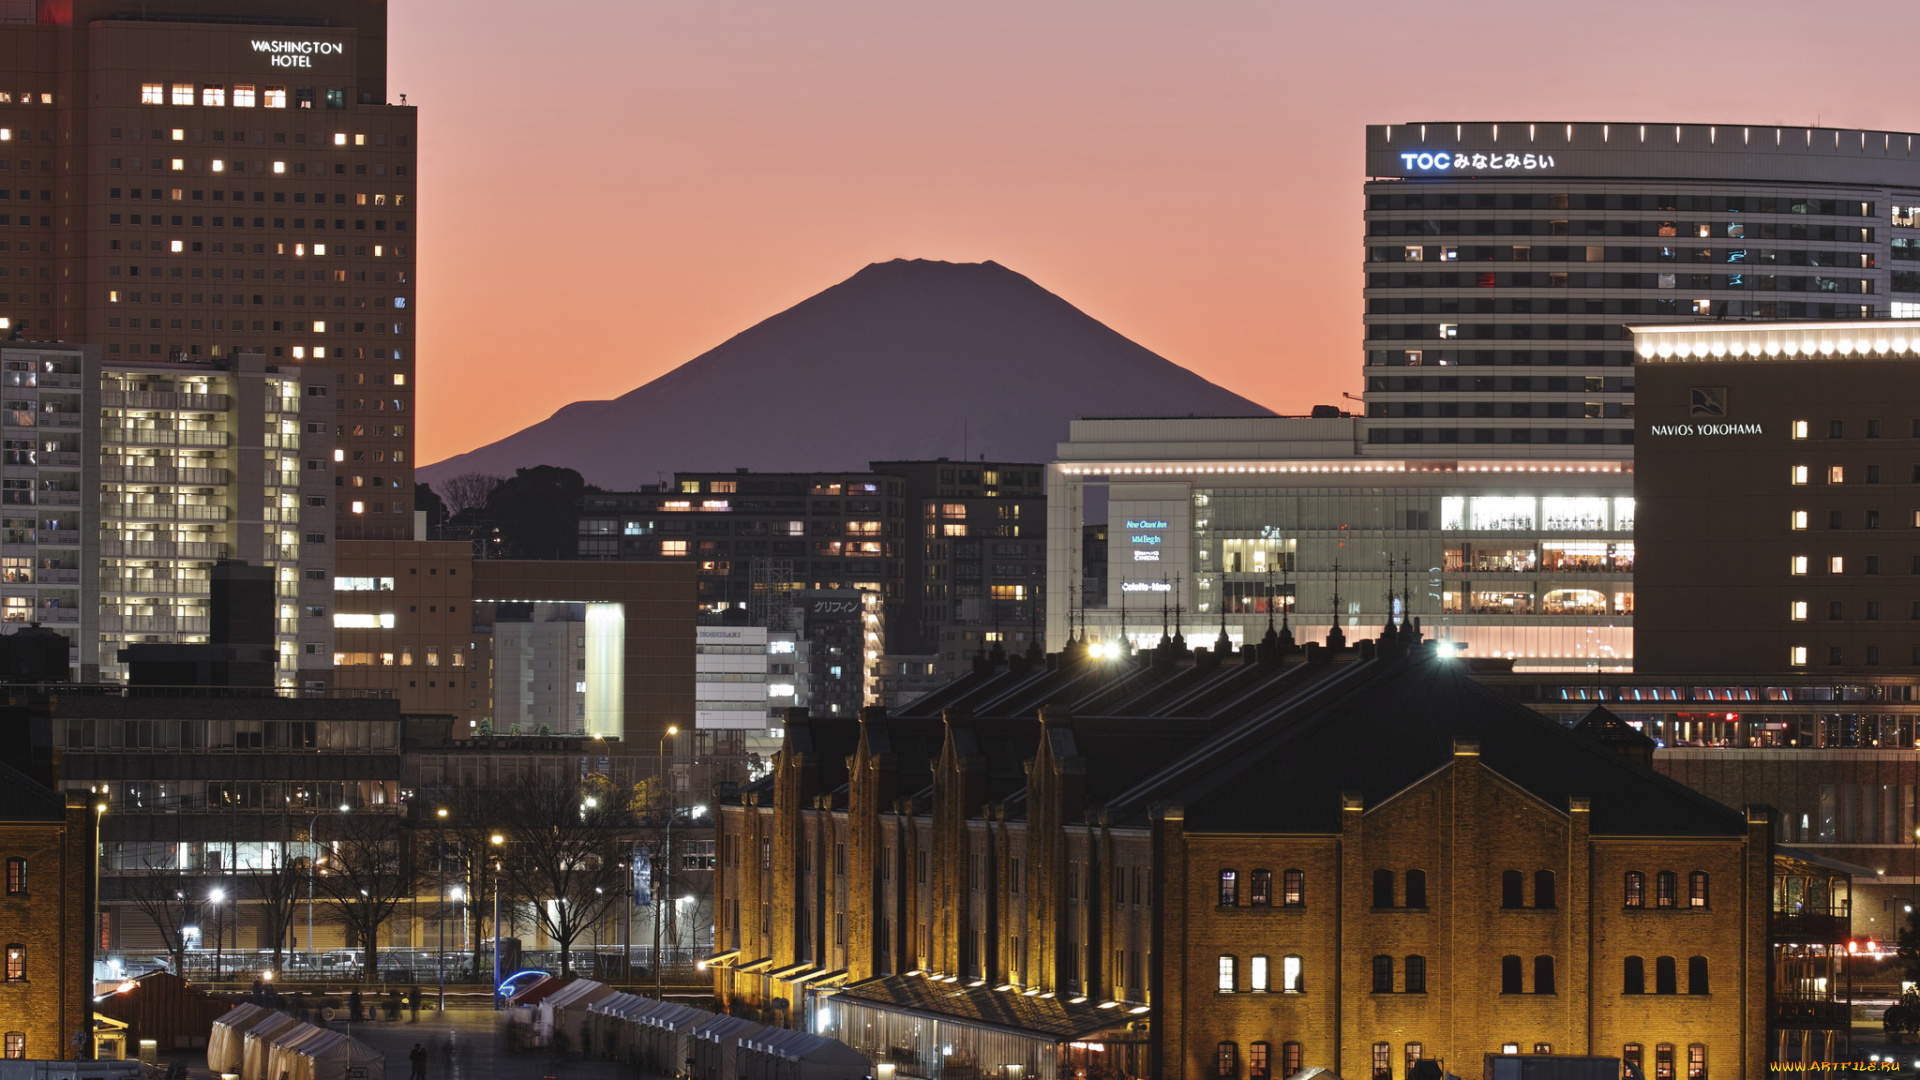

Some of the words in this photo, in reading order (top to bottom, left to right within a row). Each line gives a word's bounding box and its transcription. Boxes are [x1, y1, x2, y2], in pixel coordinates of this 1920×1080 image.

[251, 40, 343, 54] WASHINGTON
[271, 55, 312, 67] HOTEL
[1401, 153, 1450, 170] TOC
[1453, 153, 1555, 169] みなとみらい
[1651, 424, 1694, 436] NAVIOS
[1697, 424, 1762, 435] YOKOHAMA
[814, 601, 859, 613] グリフィン
